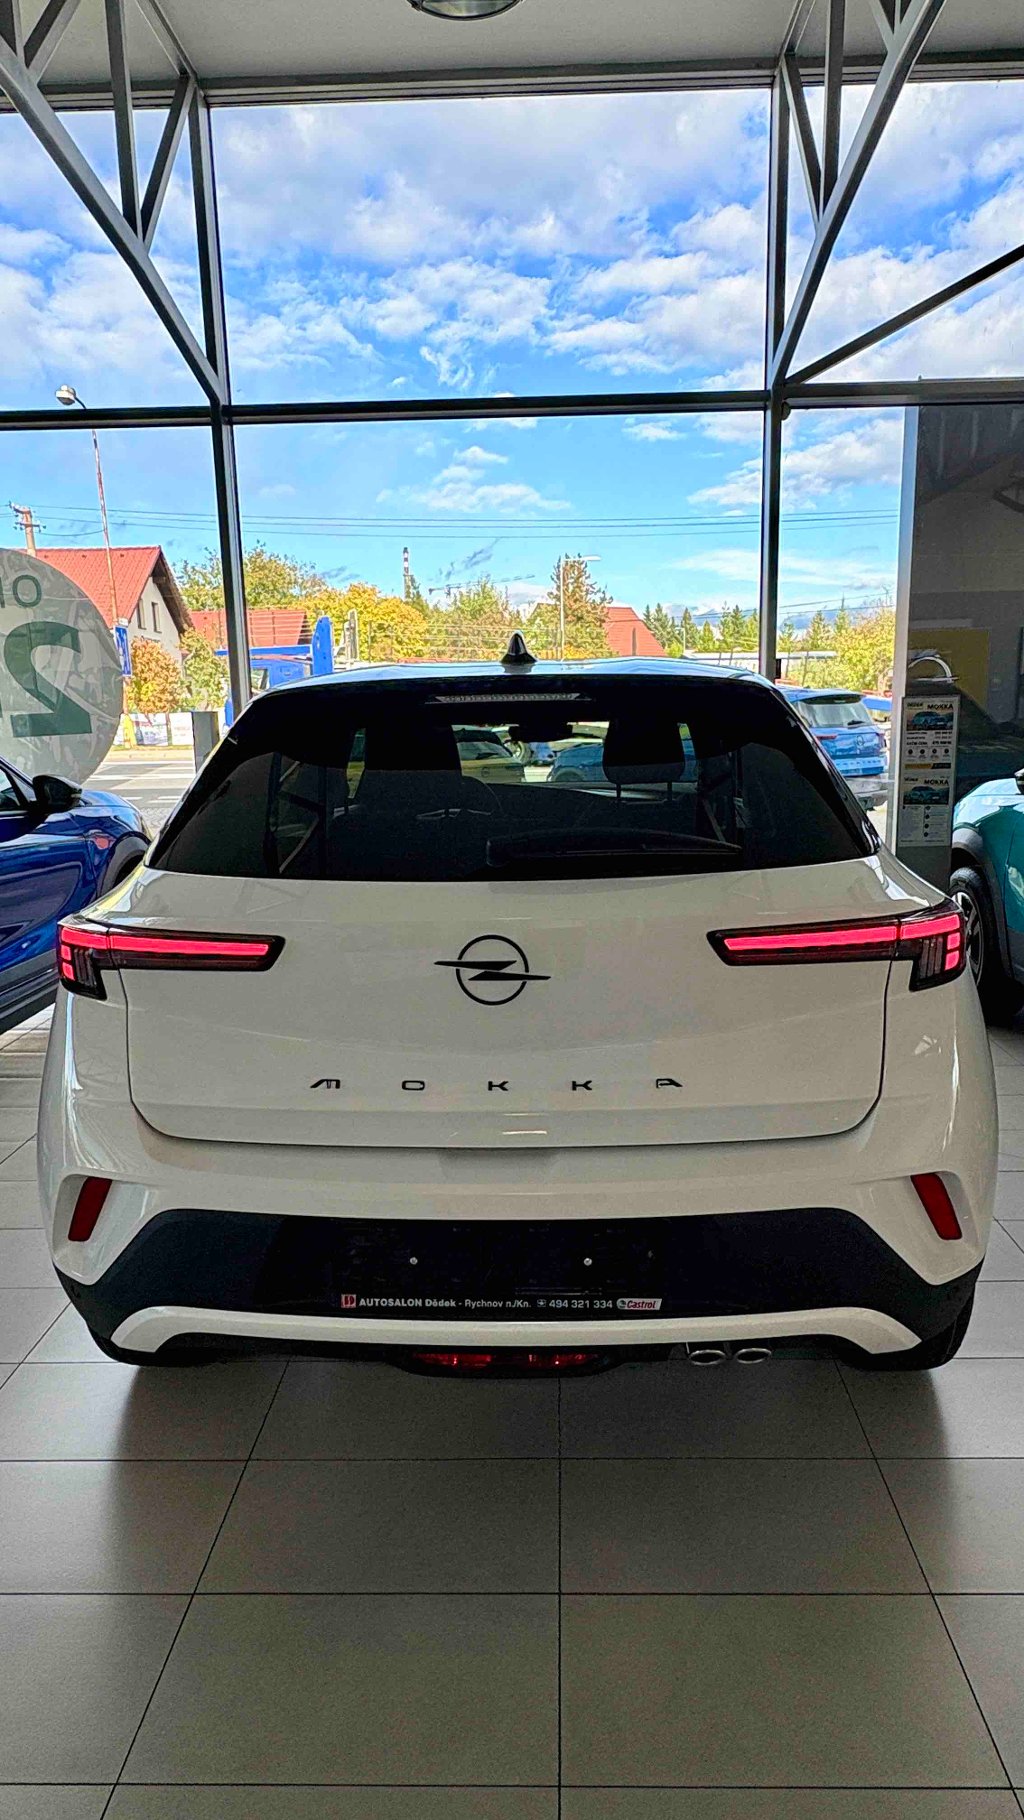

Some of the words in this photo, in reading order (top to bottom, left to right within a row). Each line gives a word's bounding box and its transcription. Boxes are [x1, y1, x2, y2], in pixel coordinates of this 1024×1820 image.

[310, 1078, 683, 1091] MOKKA
[358, 1298, 423, 1307] AUTOSALON
[464, 1299, 503, 1310] Rychnov
[549, 1299, 568, 1308] 494
[571, 1300, 590, 1309] 321
[593, 1300, 613, 1309] 334
[626, 1300, 655, 1309] Castrol
